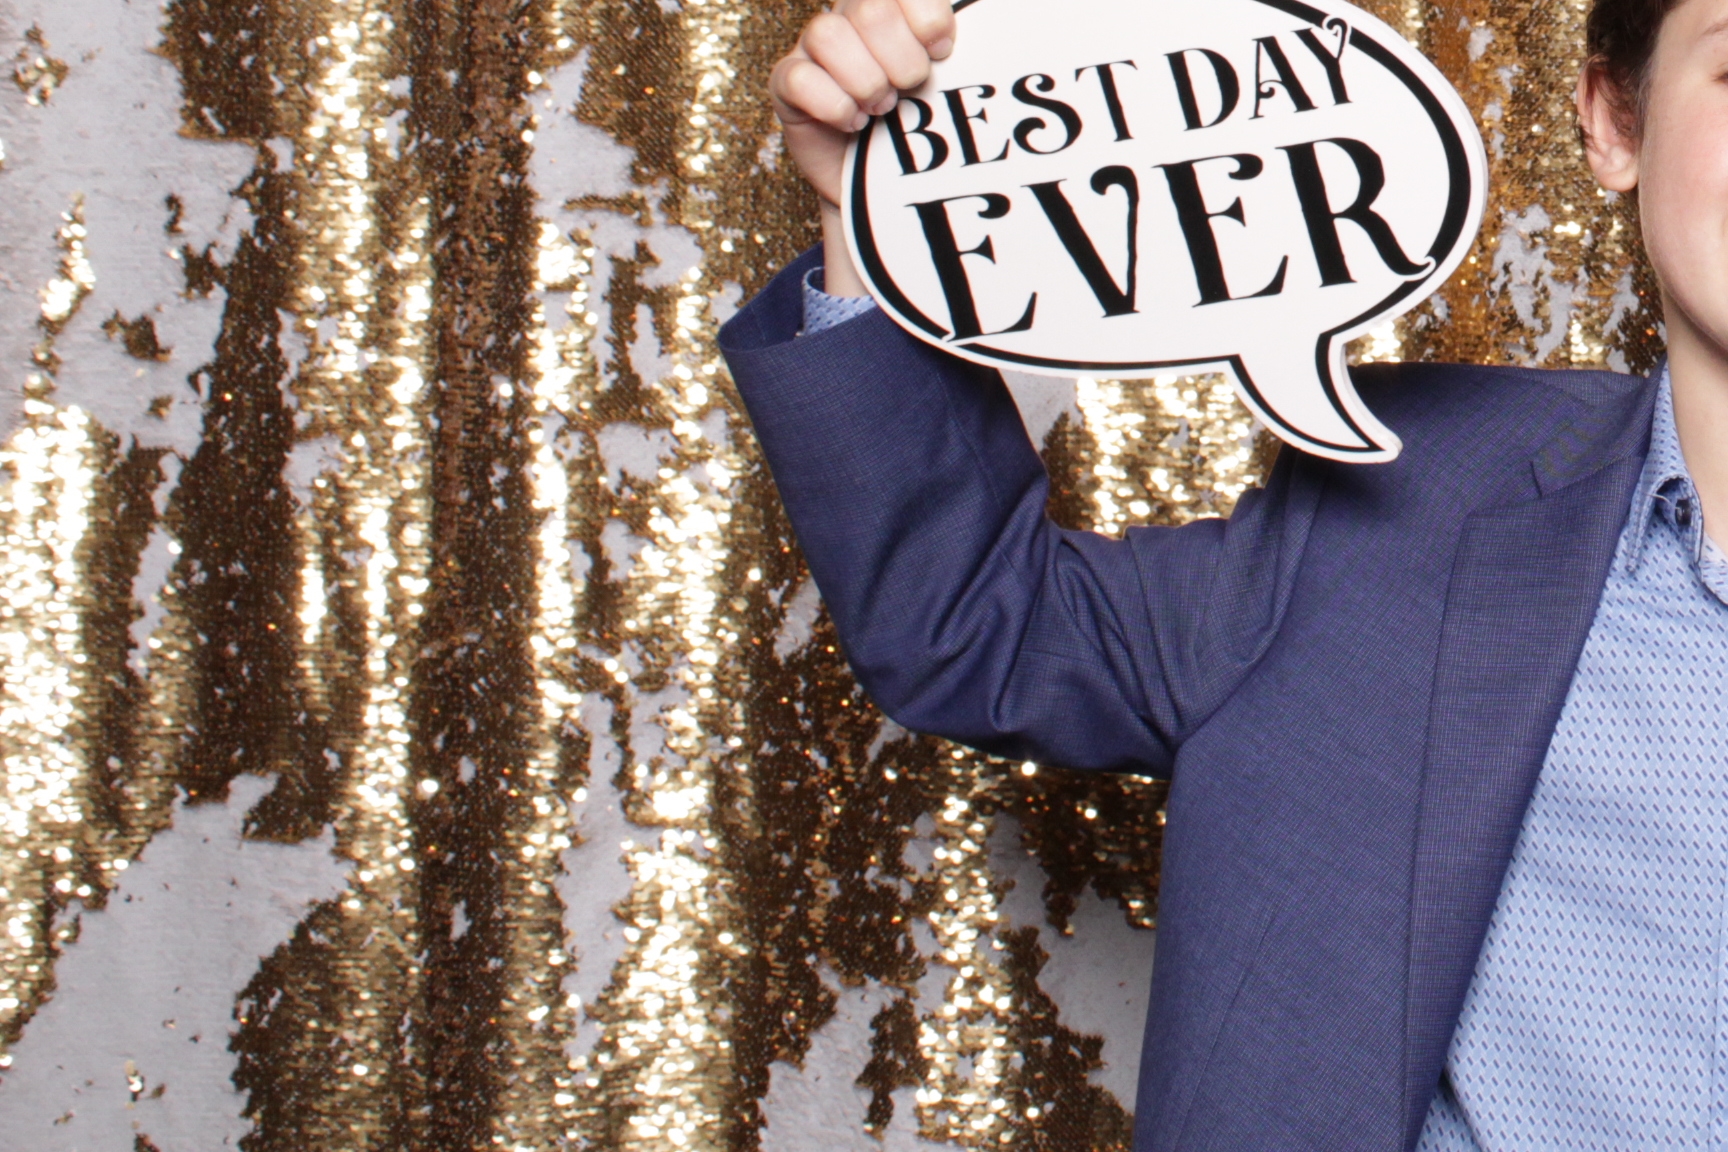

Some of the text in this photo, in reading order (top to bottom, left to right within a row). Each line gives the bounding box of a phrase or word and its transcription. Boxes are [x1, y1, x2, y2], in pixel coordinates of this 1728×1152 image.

[884, 18, 1353, 176] BEST DAY
[904, 137, 1436, 343] EVER
